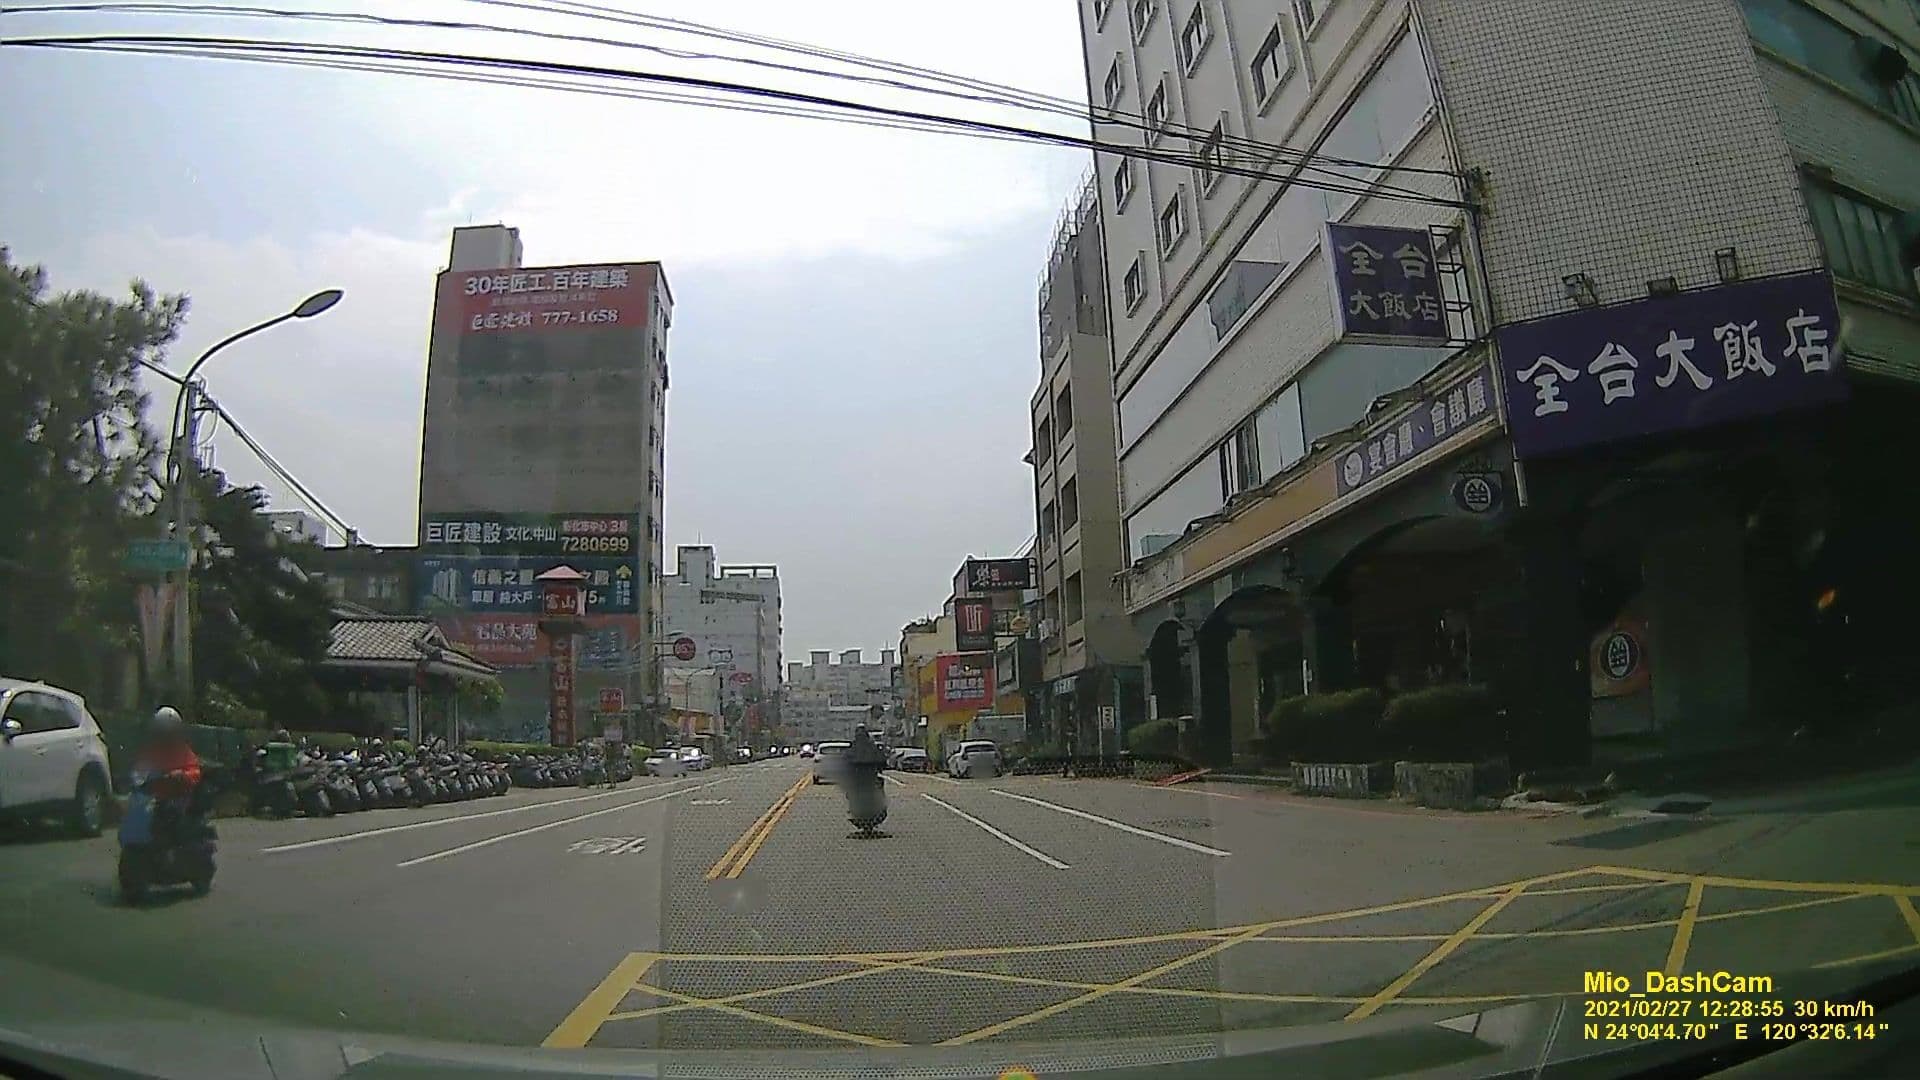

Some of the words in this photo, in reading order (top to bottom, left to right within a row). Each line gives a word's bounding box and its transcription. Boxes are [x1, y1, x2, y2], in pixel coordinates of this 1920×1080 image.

[1339, 240, 1430, 279] 全台
[541, 309, 619, 325] 777-1658
[1348, 290, 1440, 323] 大飯店
[1516, 308, 1833, 418] 全台大飯店
[426, 522, 502, 544] 巨匠建設
[561, 536, 629, 552] 7280699
